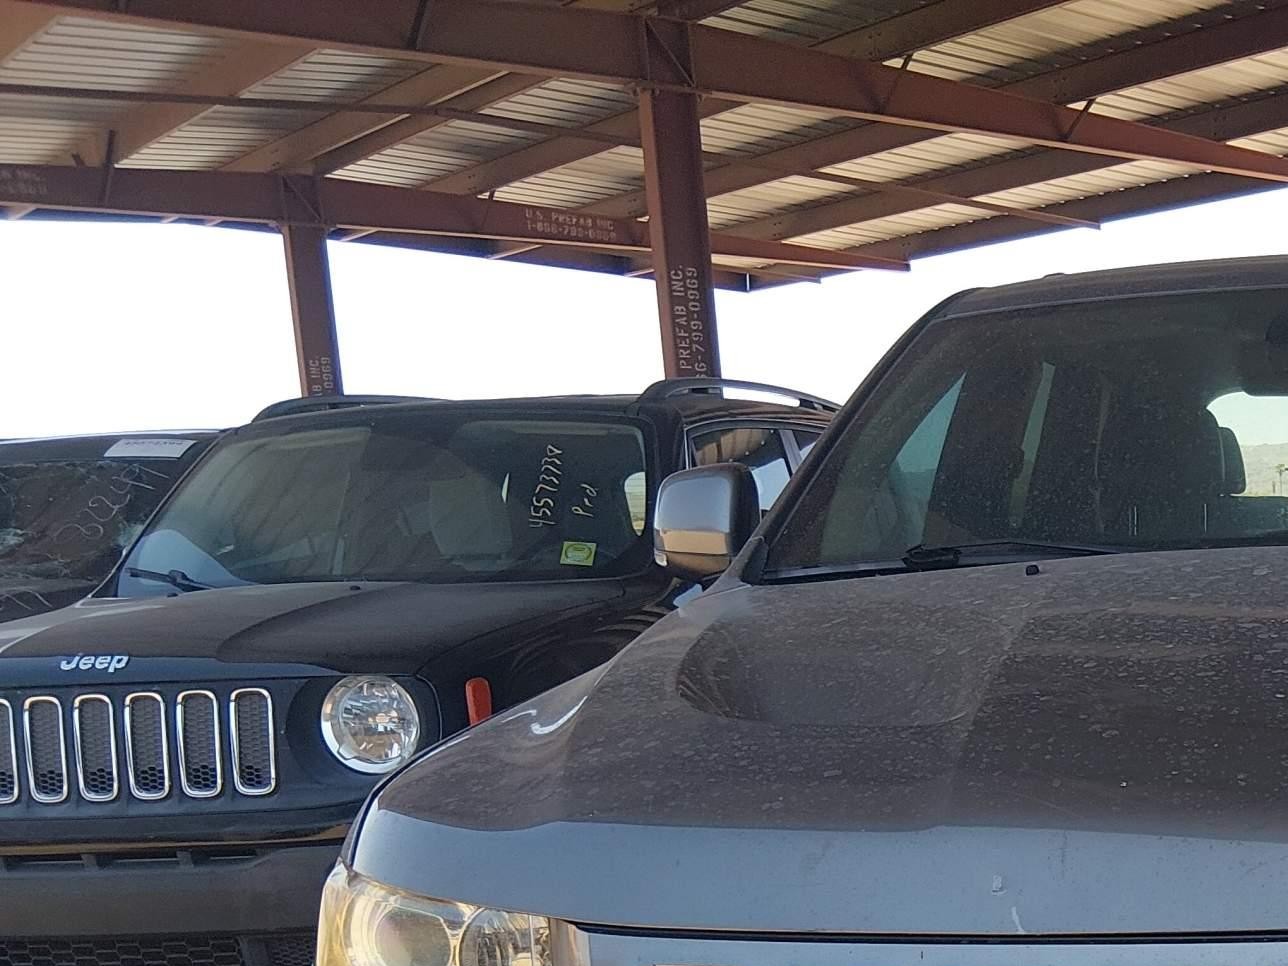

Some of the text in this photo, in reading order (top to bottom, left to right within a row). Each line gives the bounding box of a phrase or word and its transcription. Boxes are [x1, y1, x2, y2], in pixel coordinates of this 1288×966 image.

[670, 265, 692, 369] PREFAB INC.
[60, 655, 129, 673] Jeep
